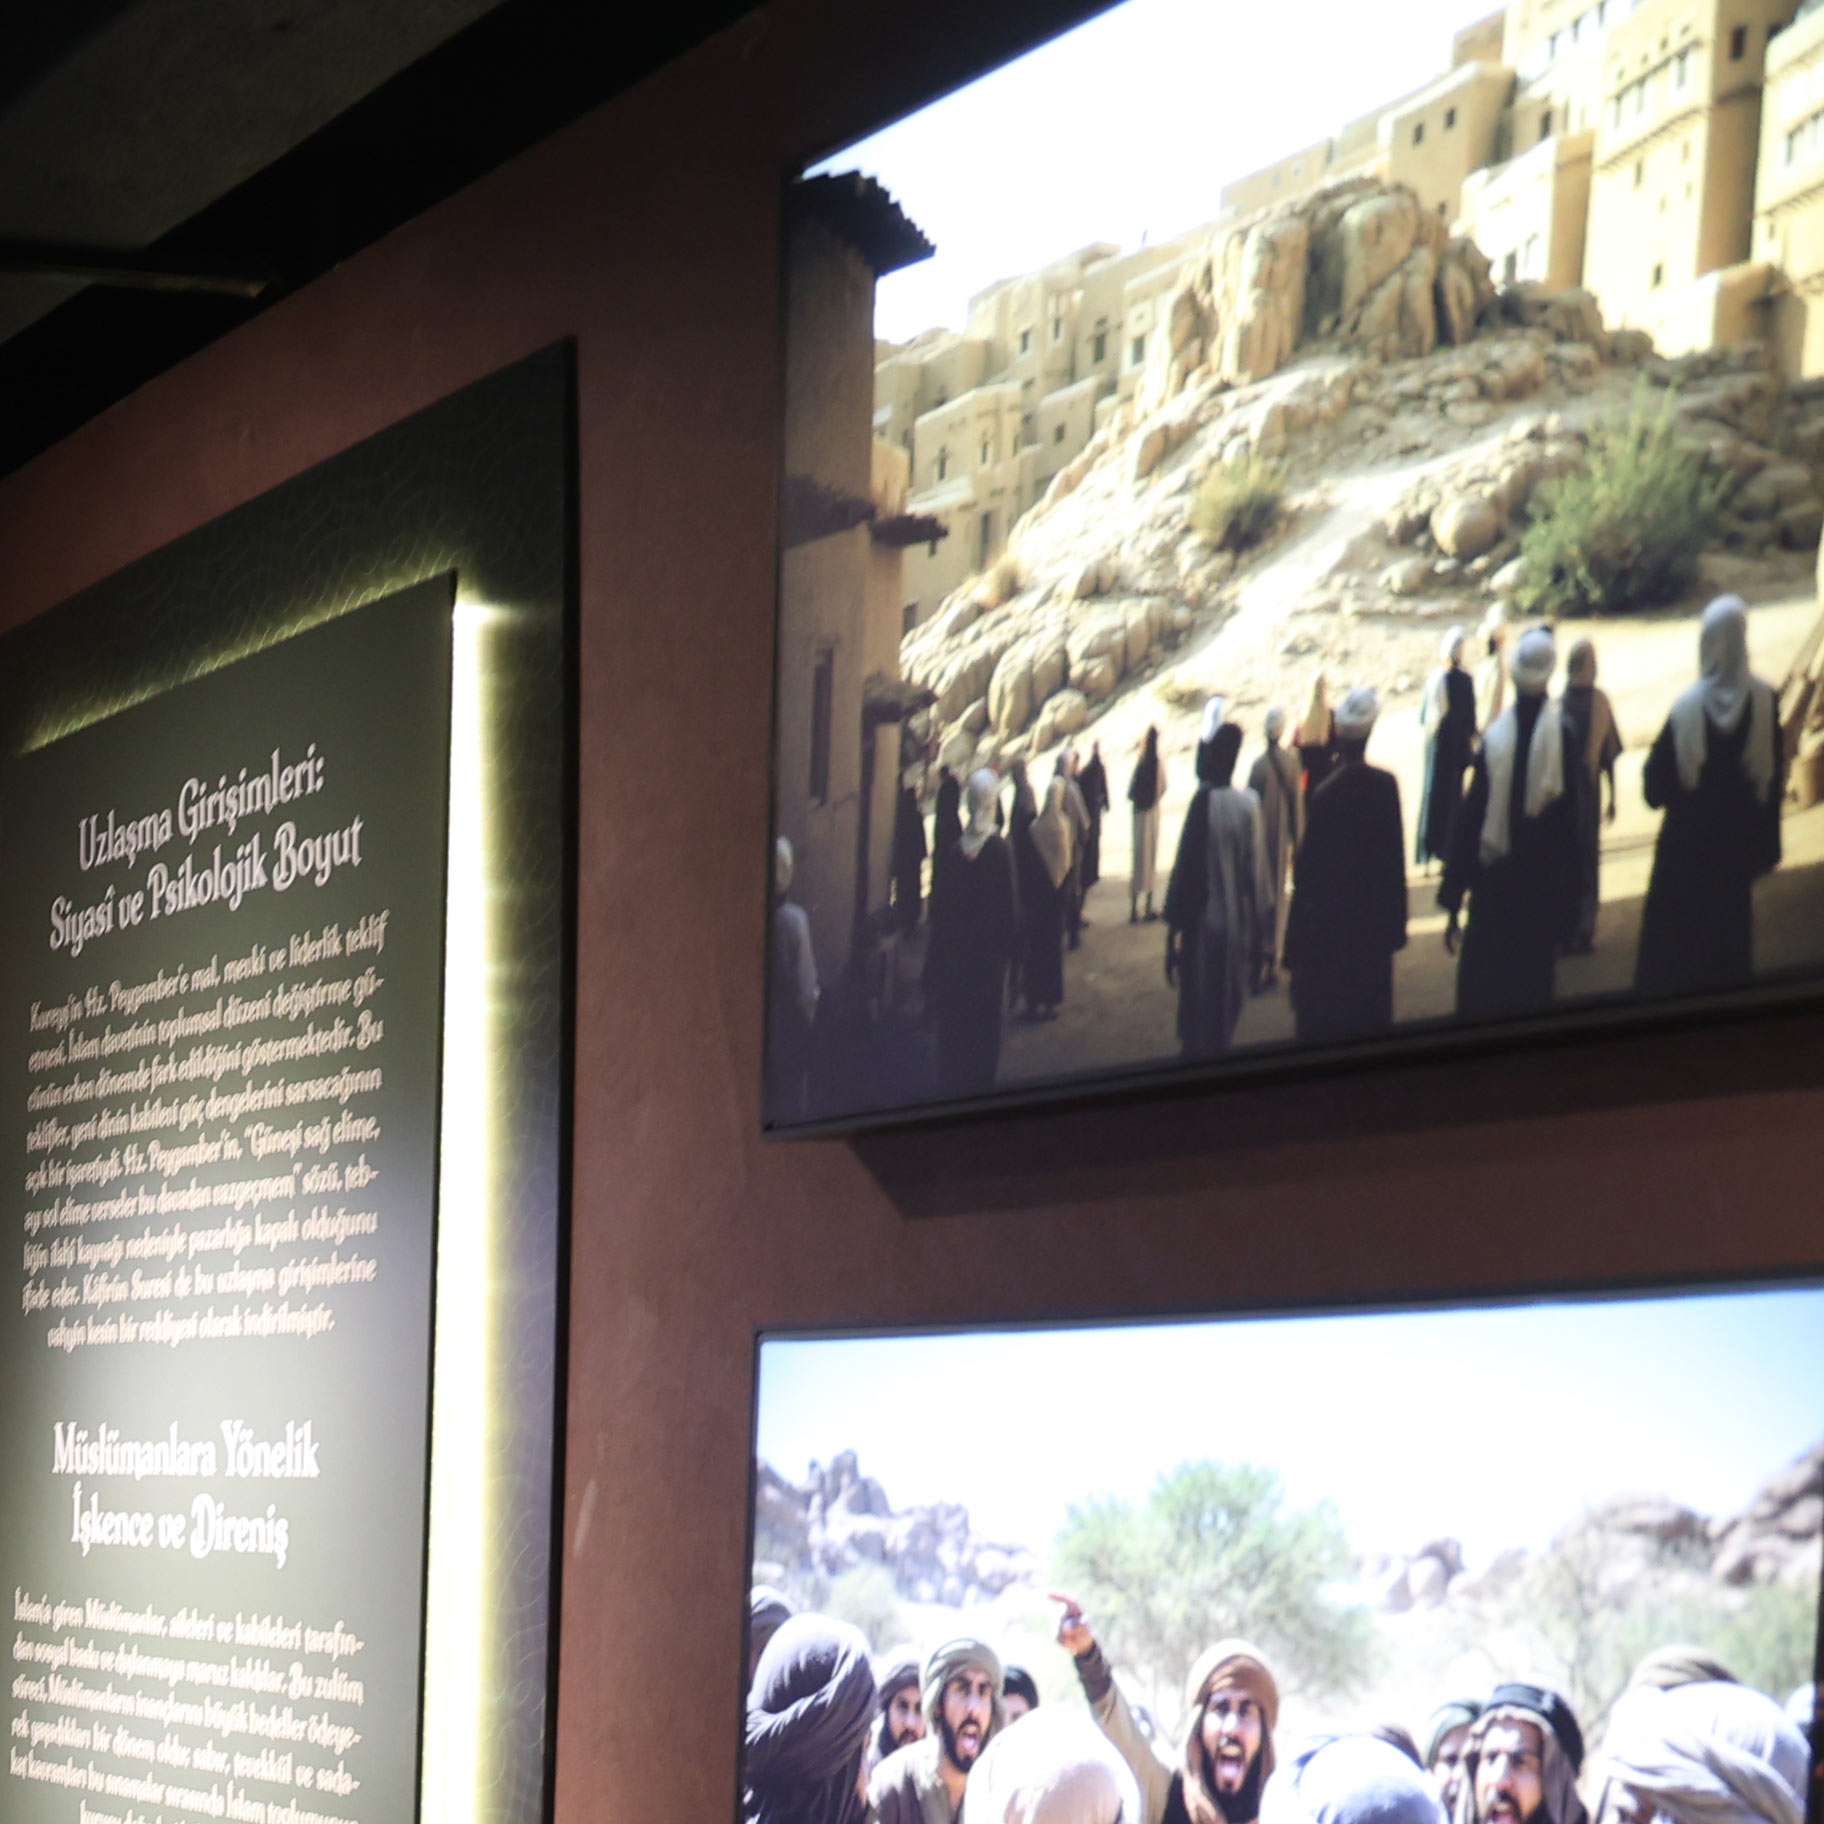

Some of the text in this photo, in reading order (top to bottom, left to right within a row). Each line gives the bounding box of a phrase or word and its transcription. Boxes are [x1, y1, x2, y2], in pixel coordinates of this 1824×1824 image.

[78, 742, 324, 871] Uzlaşma Girişimleri:
[49, 814, 364, 957] Siyasî ve Psikolojik Boyut
[84, 985, 108, 1018] Hz.
[223, 943, 267, 985] mevki
[268, 947, 287, 973] ve
[288, 922, 343, 968] liderlik
[345, 909, 390, 957] teklif
[67, 1029, 100, 1064] İslam
[100, 1018, 157, 1058] davetinin
[157, 996, 223, 1048] toplumsal
[222, 989, 272, 1030] düzeni
[272, 977, 352, 1022] değiştirme
[353, 966, 385, 1008] gü-
[61, 1072, 95, 1105] erken
[94, 1058, 151, 1099] dönemde
[149, 1051, 178, 1095] fark
[241, 1016, 356, 1077] göstermektedir.
[356, 1009, 384, 1050] Bu
[96, 1107, 130, 1141] dinin
[178, 1094, 206, 1132] güç
[204, 1077, 285, 1124] dengelerini
[284, 1065, 383, 1106] sarsacağının
[47, 1158, 66, 1188] bir
[122, 1142, 147, 1176] Hz.
[303, 1116, 332, 1155] sağ
[332, 1108, 381, 1144] elime,
[42, 1197, 60, 1229] sol
[59, 1195, 91, 1226] elime
[90, 1187, 138, 1222] verseler
[137, 1184, 157, 1216] bu
[155, 1176, 212, 1216] davadan
[344, 1153, 380, 1193] teb-
[125, 1204, 378, 1263] nedeniyle pazarlığa kapalı olduğunu
[173, 1264, 193, 1300] de
[193, 1263, 215, 1296] bu
[216, 1259, 276, 1299] uzlaşma
[277, 1250, 377, 1297] girişimlerine
[118, 1312, 139, 1344] bir
[198, 1304, 243, 1339] olarak
[51, 1418, 321, 1479] Müslümanlara Yönelik
[70, 1482, 289, 1567] İşkence ve Direniş
